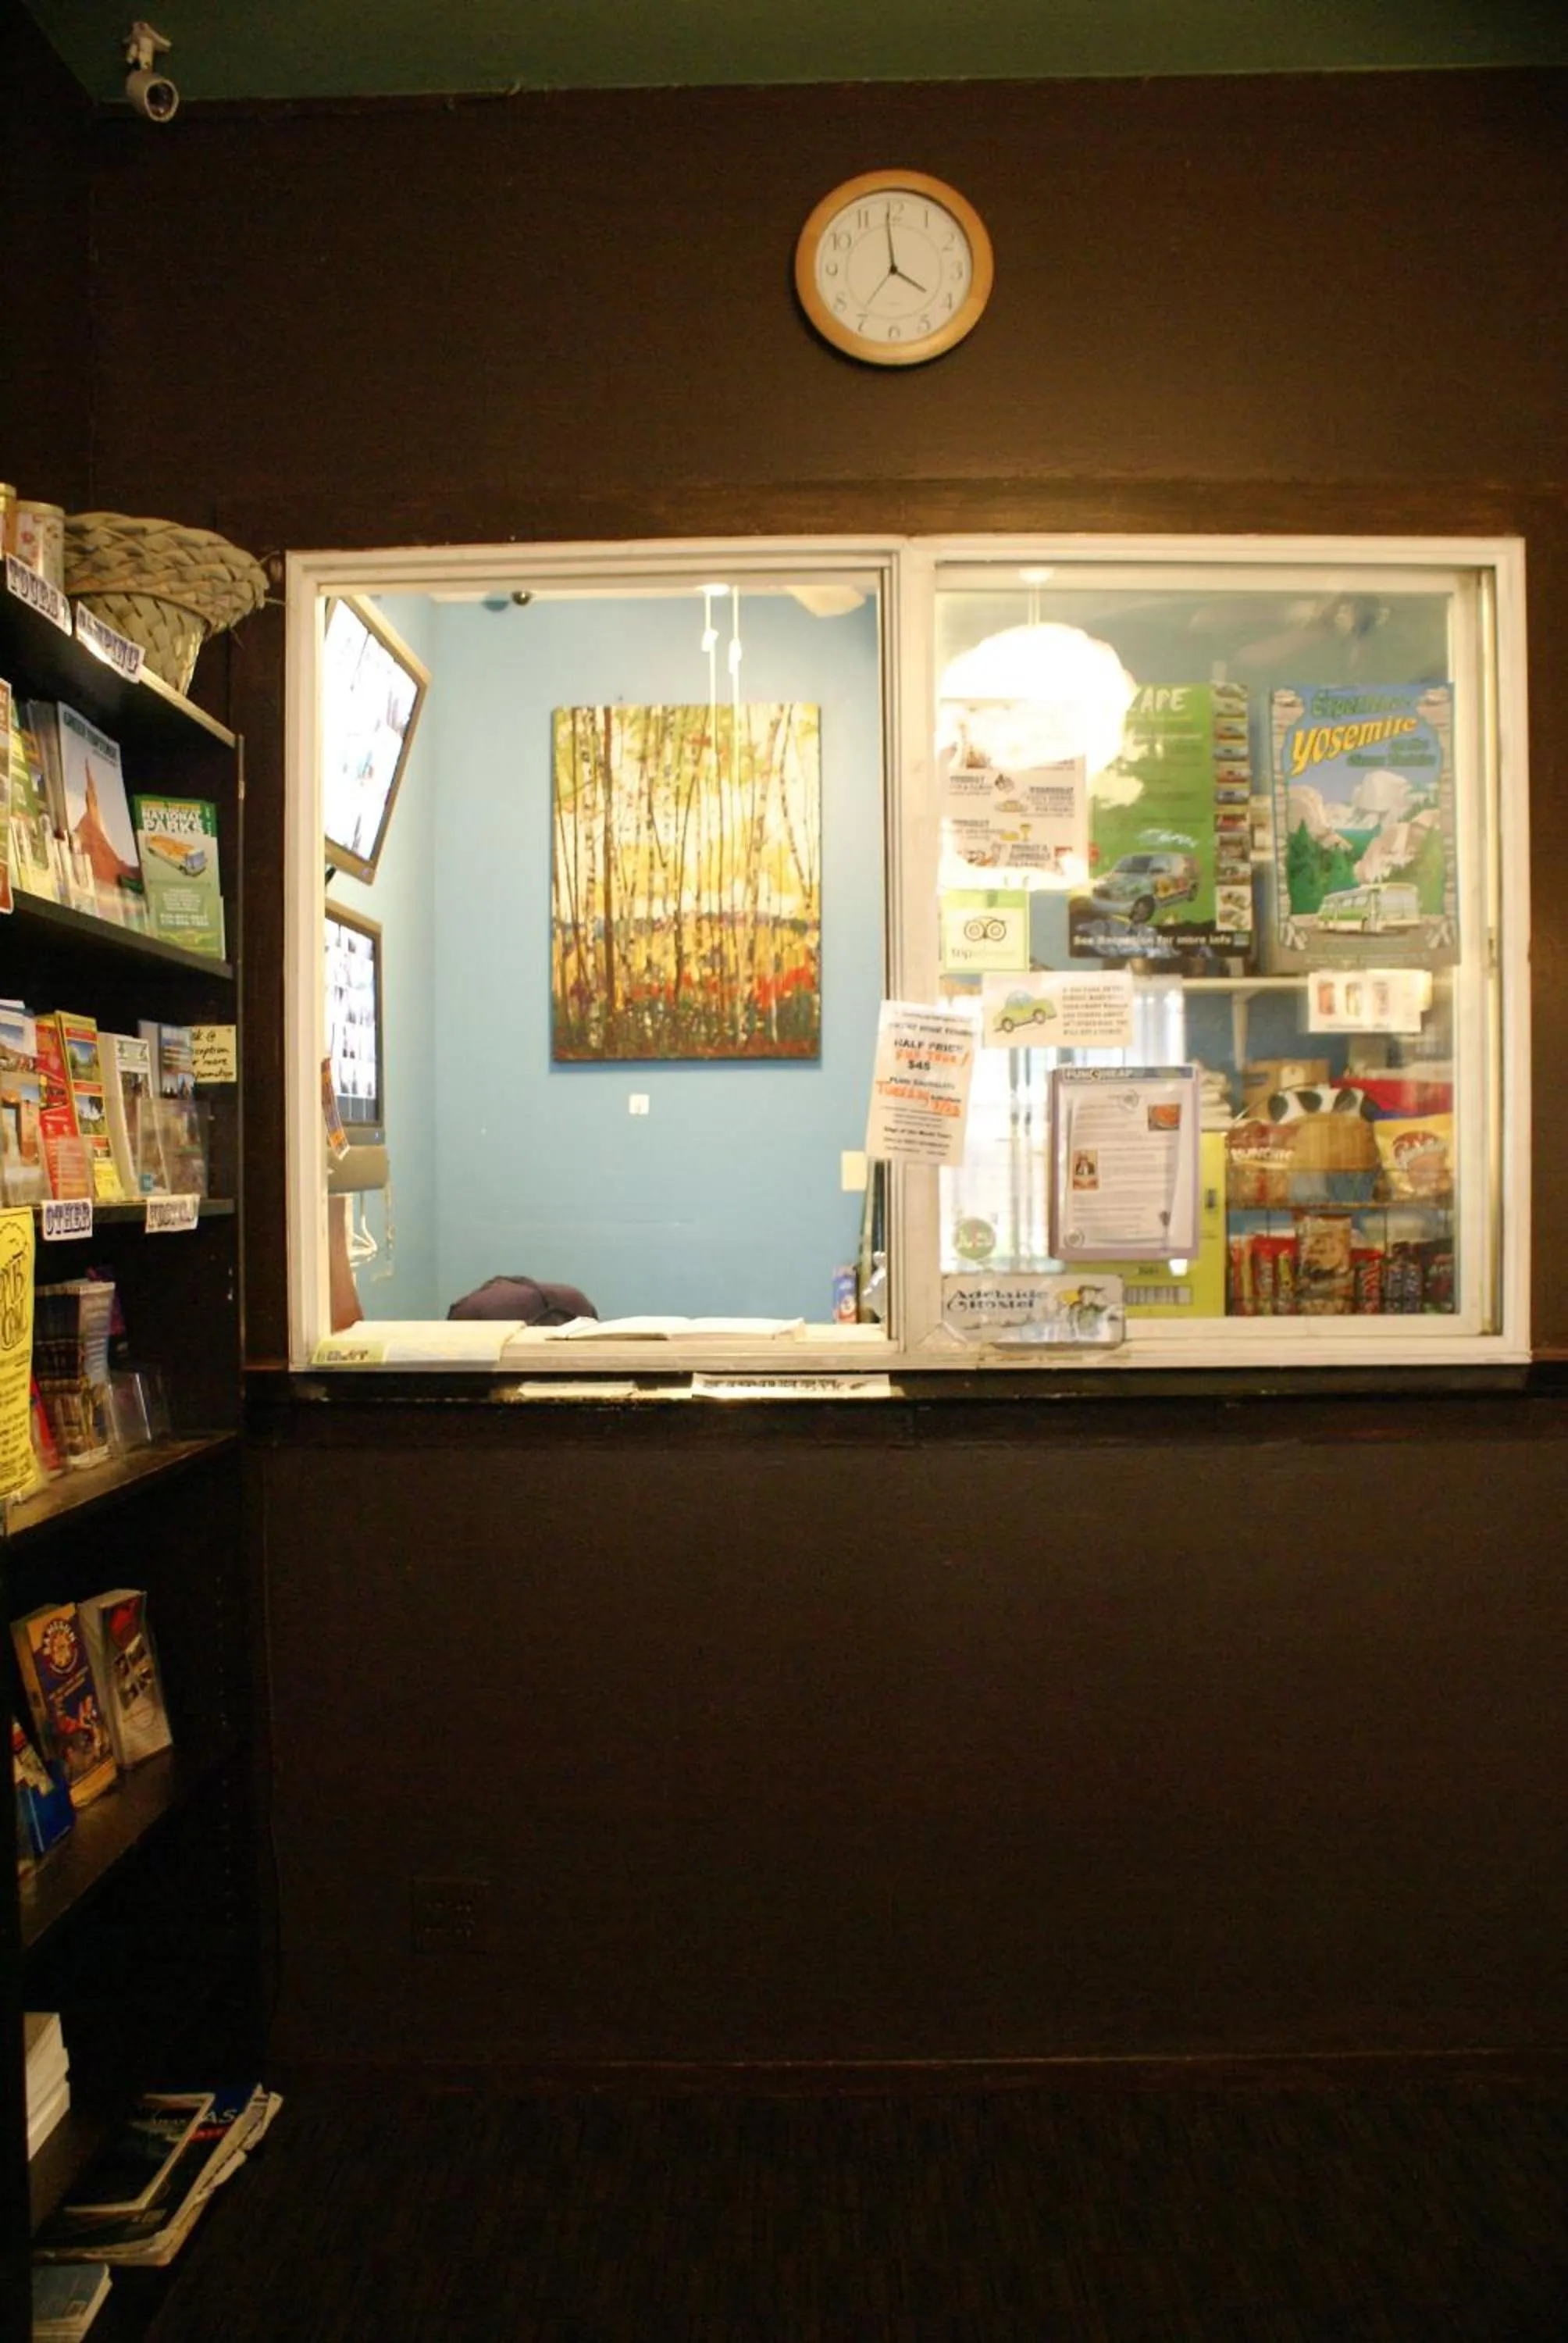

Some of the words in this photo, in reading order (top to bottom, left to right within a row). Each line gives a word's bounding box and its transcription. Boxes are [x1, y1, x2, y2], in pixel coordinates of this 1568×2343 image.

[857, 209, 869, 229] 11
[923, 205, 929, 229] 1
[832, 234, 852, 251] 10
[942, 234, 955, 251] 2
[825, 260, 839, 276] 9
[950, 260, 963, 280] 3
[833, 291, 847, 312] 8
[940, 292, 953, 311] 4
[857, 313, 868, 332] 7
[887, 324, 901, 339] 6
[917, 314, 932, 333] 5
[1291, 715, 1419, 776] Yosemite
[143, 819, 203, 833] PARKS
[1210, 935, 1232, 946] info
